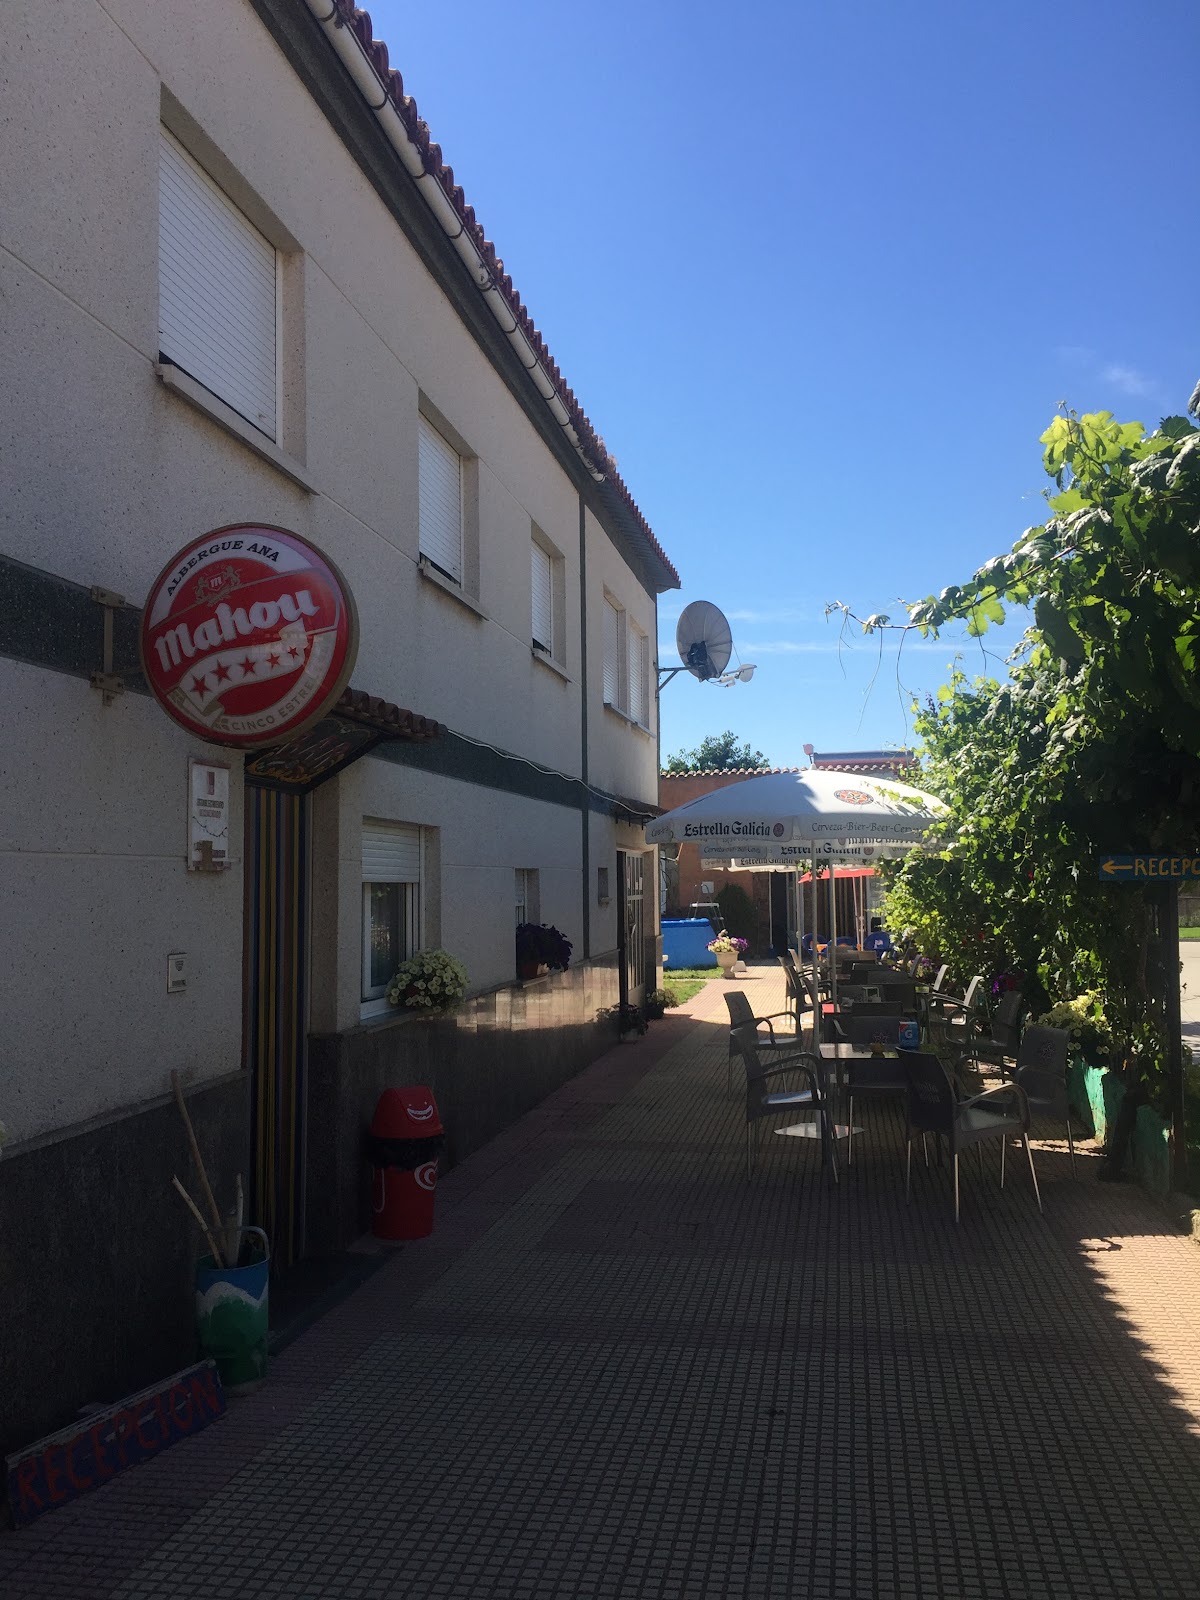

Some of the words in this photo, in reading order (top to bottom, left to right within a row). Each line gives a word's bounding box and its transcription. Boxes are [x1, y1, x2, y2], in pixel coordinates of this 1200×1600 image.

[166, 540, 244, 597] ALBERGUE
[246, 542, 281, 562] ANA
[154, 589, 320, 673] Mahou
[231, 715, 275, 732] CINCO
[684, 822, 730, 837] Estrella
[731, 820, 770, 836] Galicia
[904, 1029, 913, 1039] G
[16, 1368, 223, 1514] RECEPCION
